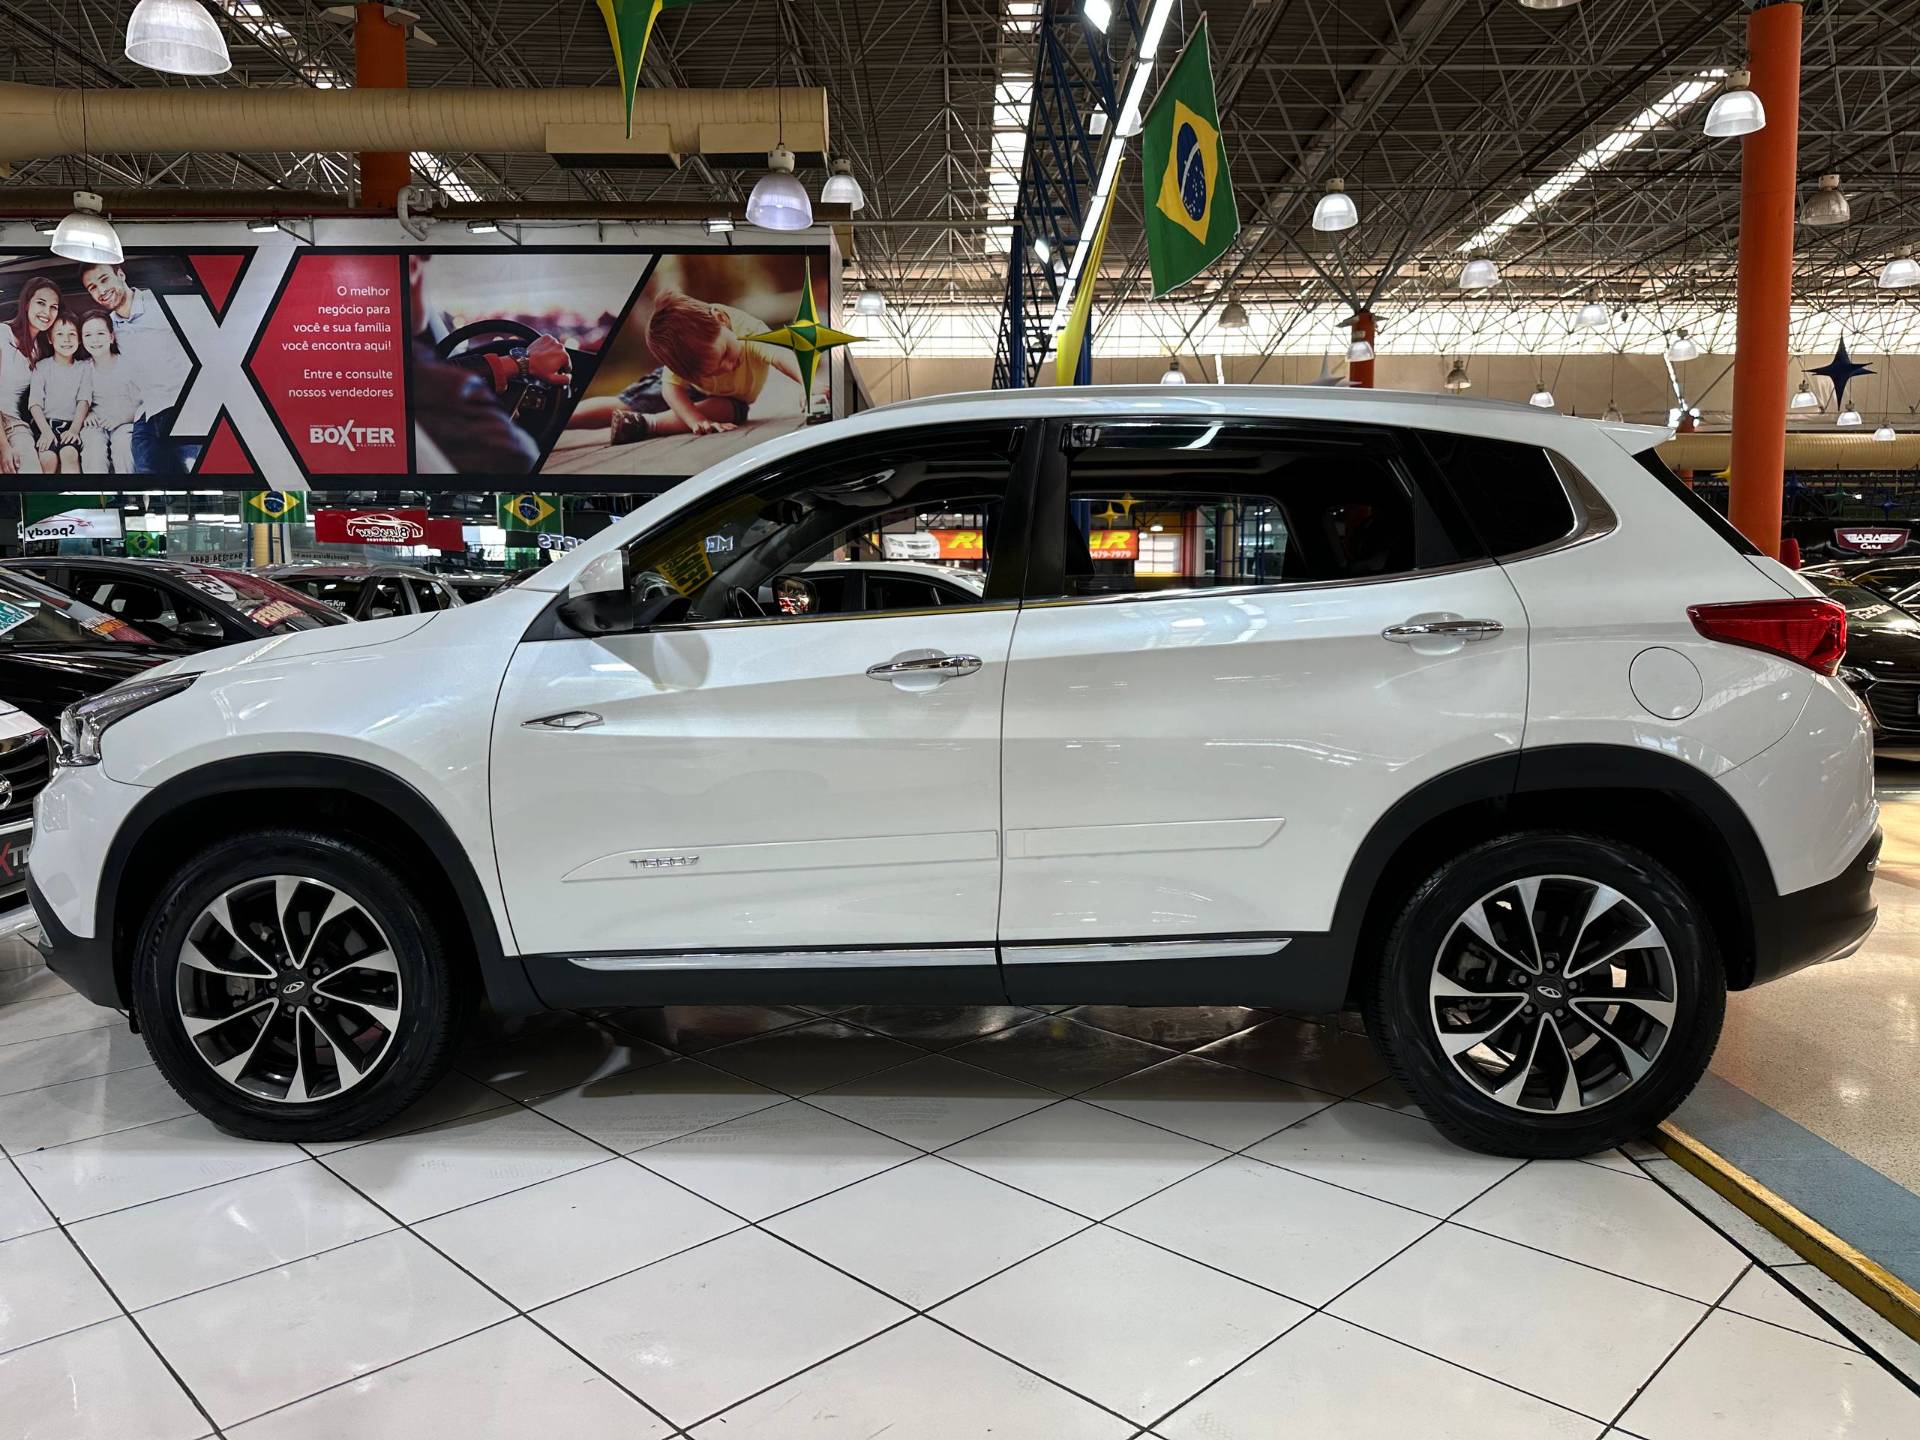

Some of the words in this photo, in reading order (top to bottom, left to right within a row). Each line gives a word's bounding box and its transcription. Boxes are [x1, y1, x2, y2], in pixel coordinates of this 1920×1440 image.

[337, 286, 347, 296] O
[350, 286, 390, 296] melhor
[318, 305, 363, 316] negócio
[366, 306, 391, 316] para
[293, 323, 320, 332] você
[355, 322, 391, 332] família
[282, 341, 309, 350] você
[311, 341, 361, 350] encontra
[364, 341, 391, 352] aqui!
[304, 369, 333, 379] Entre
[336, 371, 342, 379] e
[345, 369, 392, 379] consulte
[289, 389, 326, 397] nossos
[329, 388, 394, 397] vendedores
[310, 419, 395, 451] BOXTER
